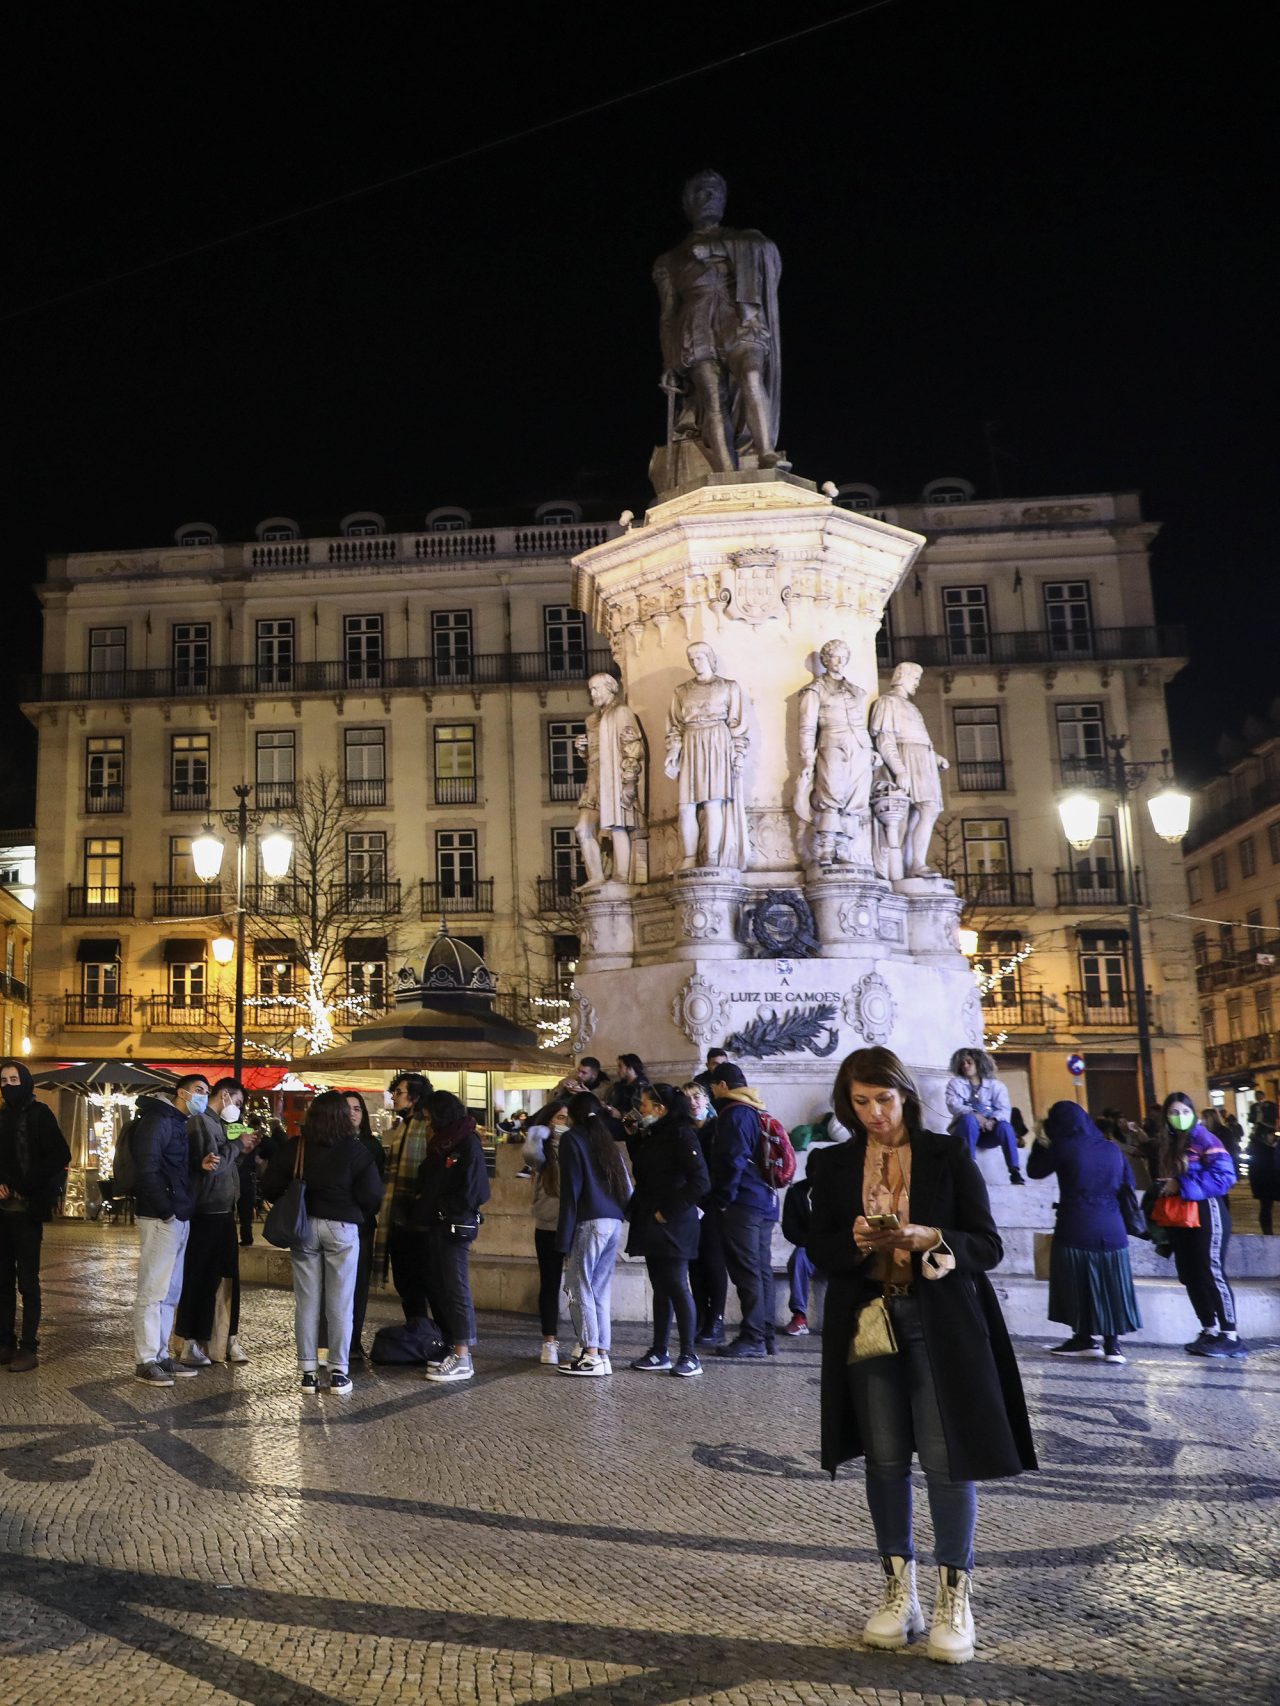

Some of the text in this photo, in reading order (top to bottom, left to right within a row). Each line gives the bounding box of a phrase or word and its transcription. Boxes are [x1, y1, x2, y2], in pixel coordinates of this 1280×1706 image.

[780, 977, 790, 986] A
[730, 992, 760, 1002] LUIZ
[765, 992, 782, 1002] DE
